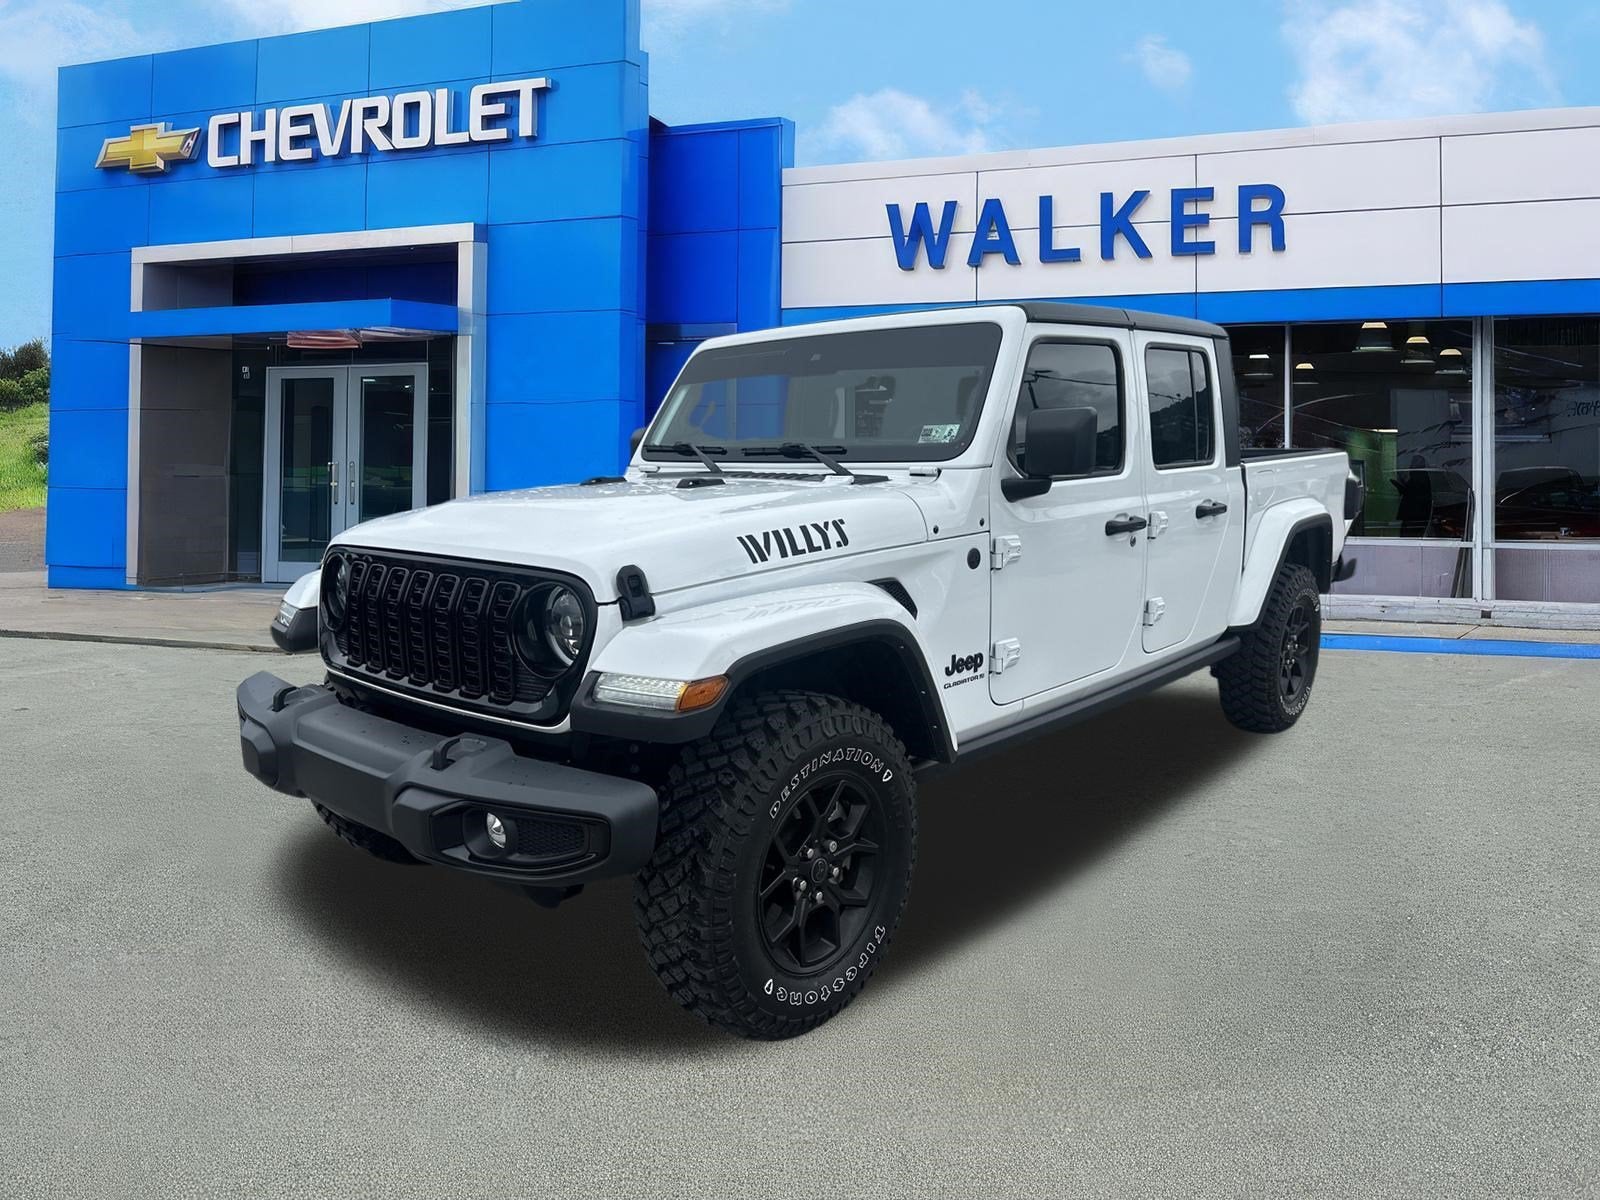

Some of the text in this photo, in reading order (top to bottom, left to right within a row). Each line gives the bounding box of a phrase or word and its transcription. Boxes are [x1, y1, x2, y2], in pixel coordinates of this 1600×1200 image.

[208, 76, 551, 168] CHEVROLET
[886, 184, 1287, 271] WALKER
[735, 518, 849, 564] WILLYS
[943, 674, 979, 690] GLADIATOR
[944, 651, 984, 677] Jeep
[769, 747, 885, 819] DESTINATION
[776, 925, 886, 1005] Firestone
